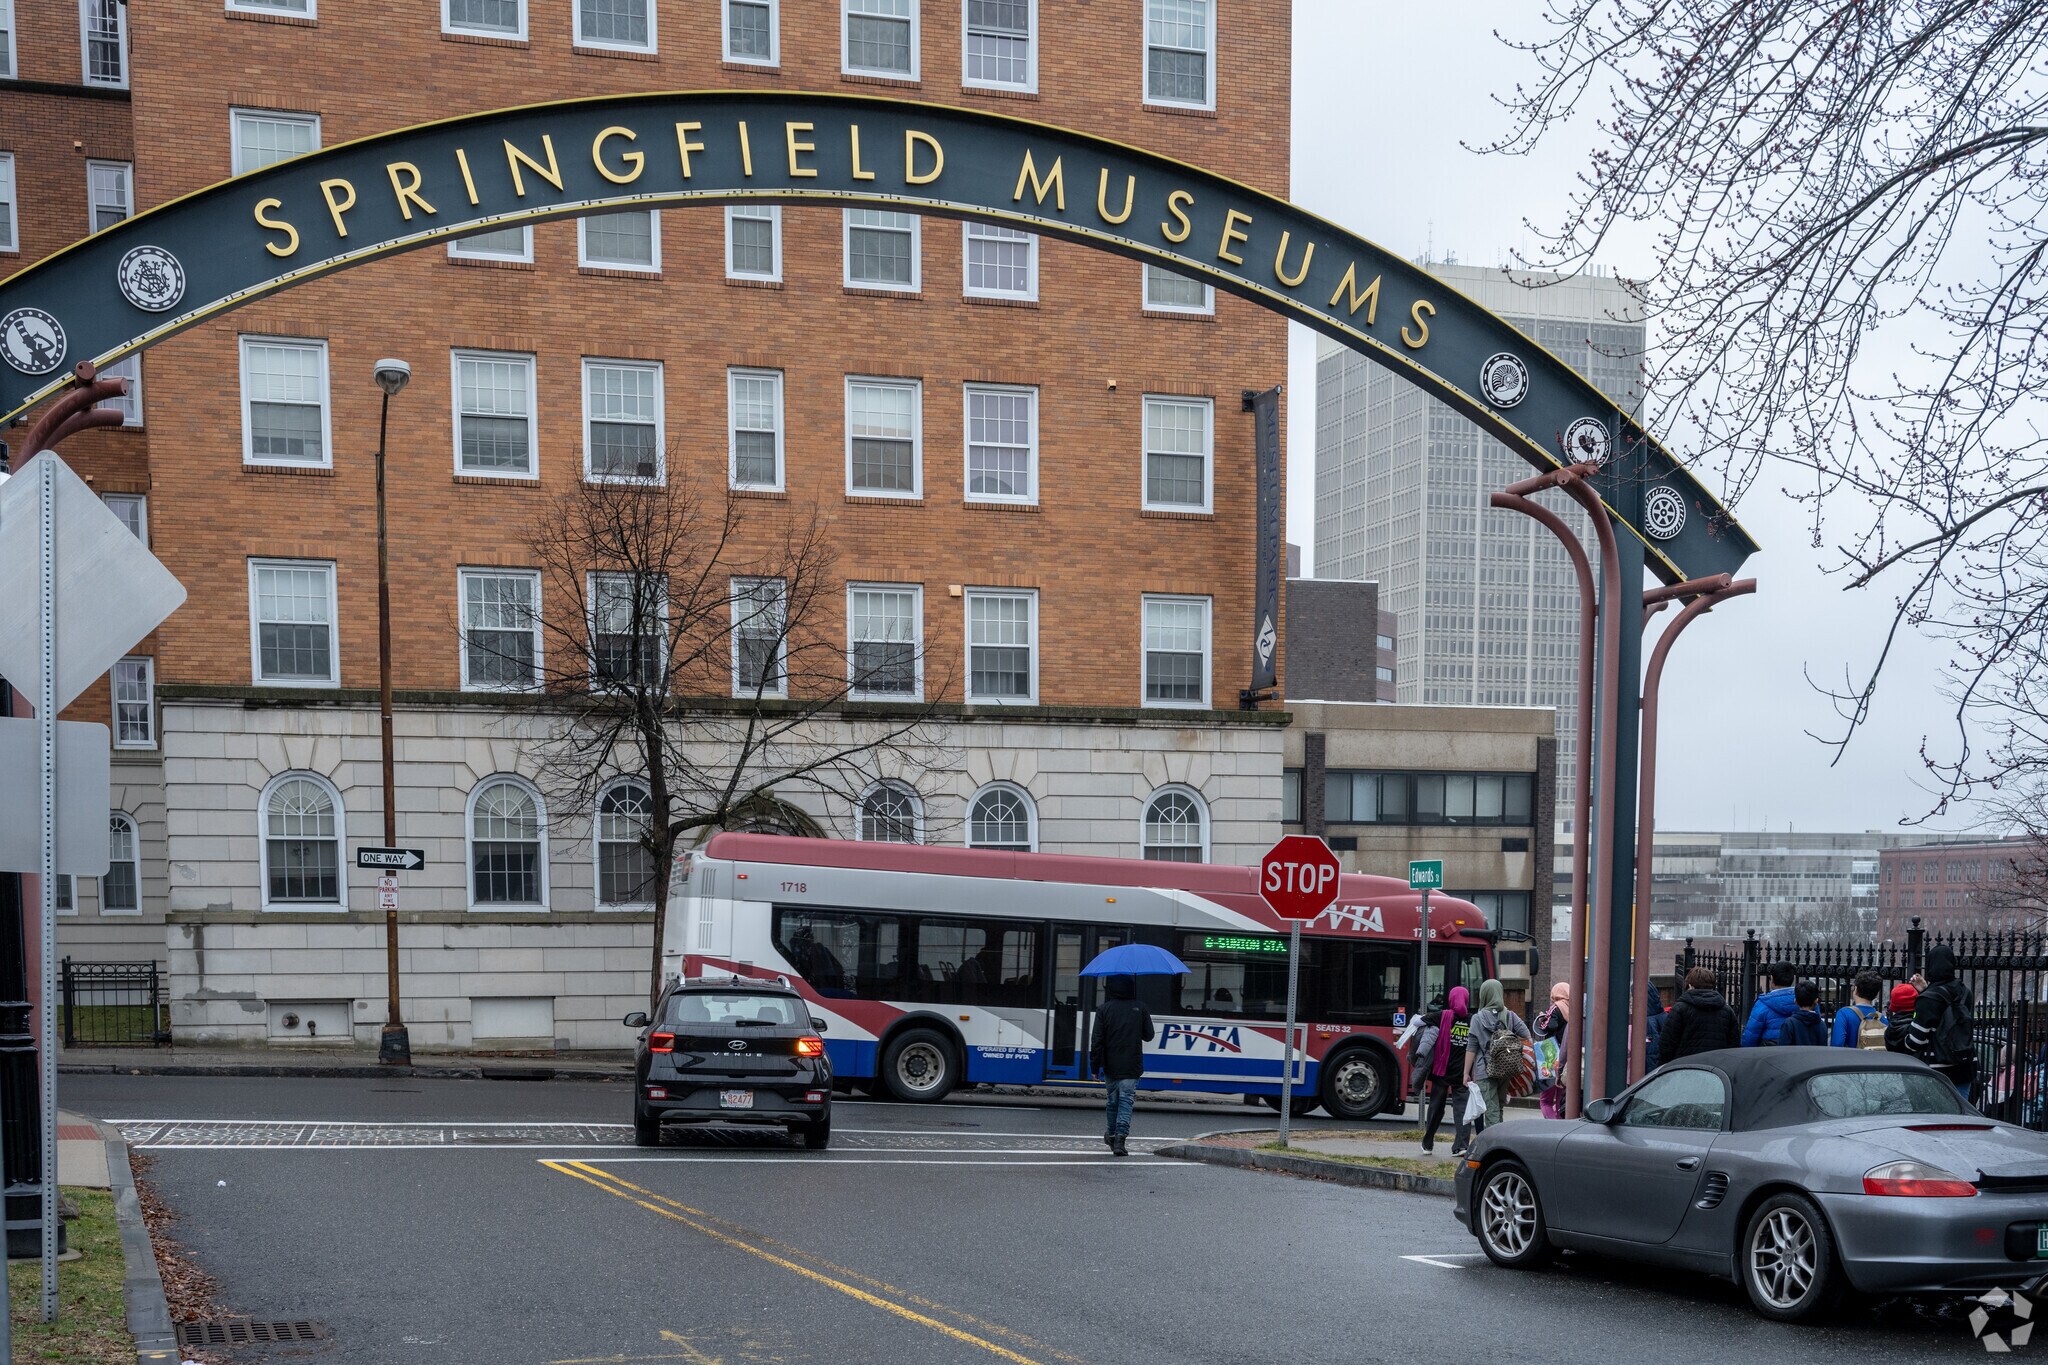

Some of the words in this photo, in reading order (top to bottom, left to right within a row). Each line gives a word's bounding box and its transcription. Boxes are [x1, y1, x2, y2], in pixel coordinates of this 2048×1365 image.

[253, 120, 945, 258] SPRINGFIELD
[1012, 147, 1437, 350] MUSEUMS
[1266, 408, 1278, 527] MUSEUM
[1268, 535, 1278, 602] PARK
[363, 853, 381, 863] ONE
[384, 854, 404, 863] WAY
[1265, 861, 1335, 894] STOP
[1411, 867, 1434, 883] Edwards
[780, 882, 807, 893] 1718
[1158, 1023, 1242, 1053] PVTA
[1315, 1024, 1341, 1033] SEATS
[1341, 1025, 1351, 1033] 32
[733, 1094, 752, 1105] 2477
